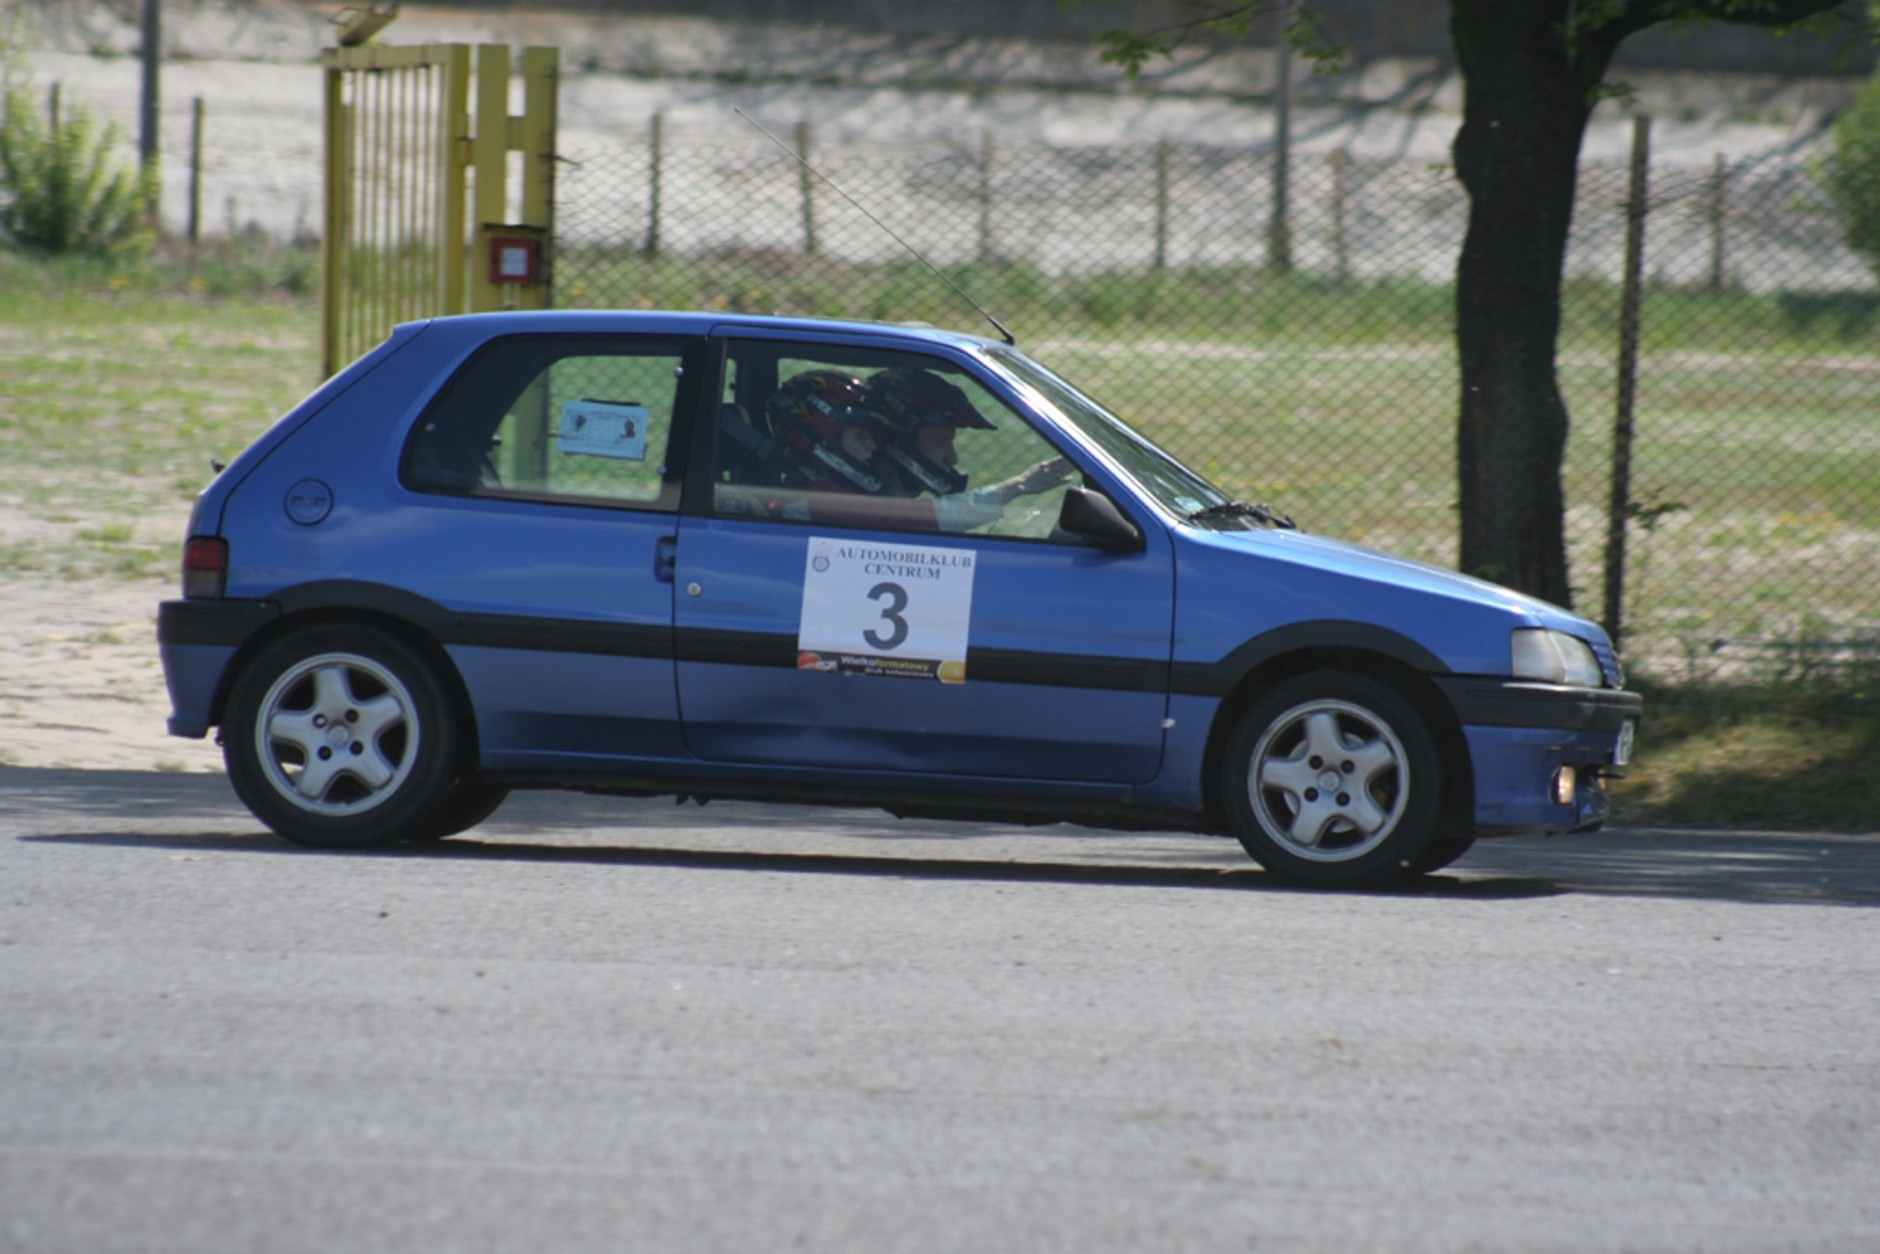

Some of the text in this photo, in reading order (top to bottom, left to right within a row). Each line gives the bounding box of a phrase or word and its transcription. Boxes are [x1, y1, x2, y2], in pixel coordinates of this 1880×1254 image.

[836, 547, 972, 568] AUTOMOBILKLUB
[864, 563, 941, 579] CENTRUM
[862, 581, 909, 651] 3
[841, 655, 930, 671] Wielkoformatowy
